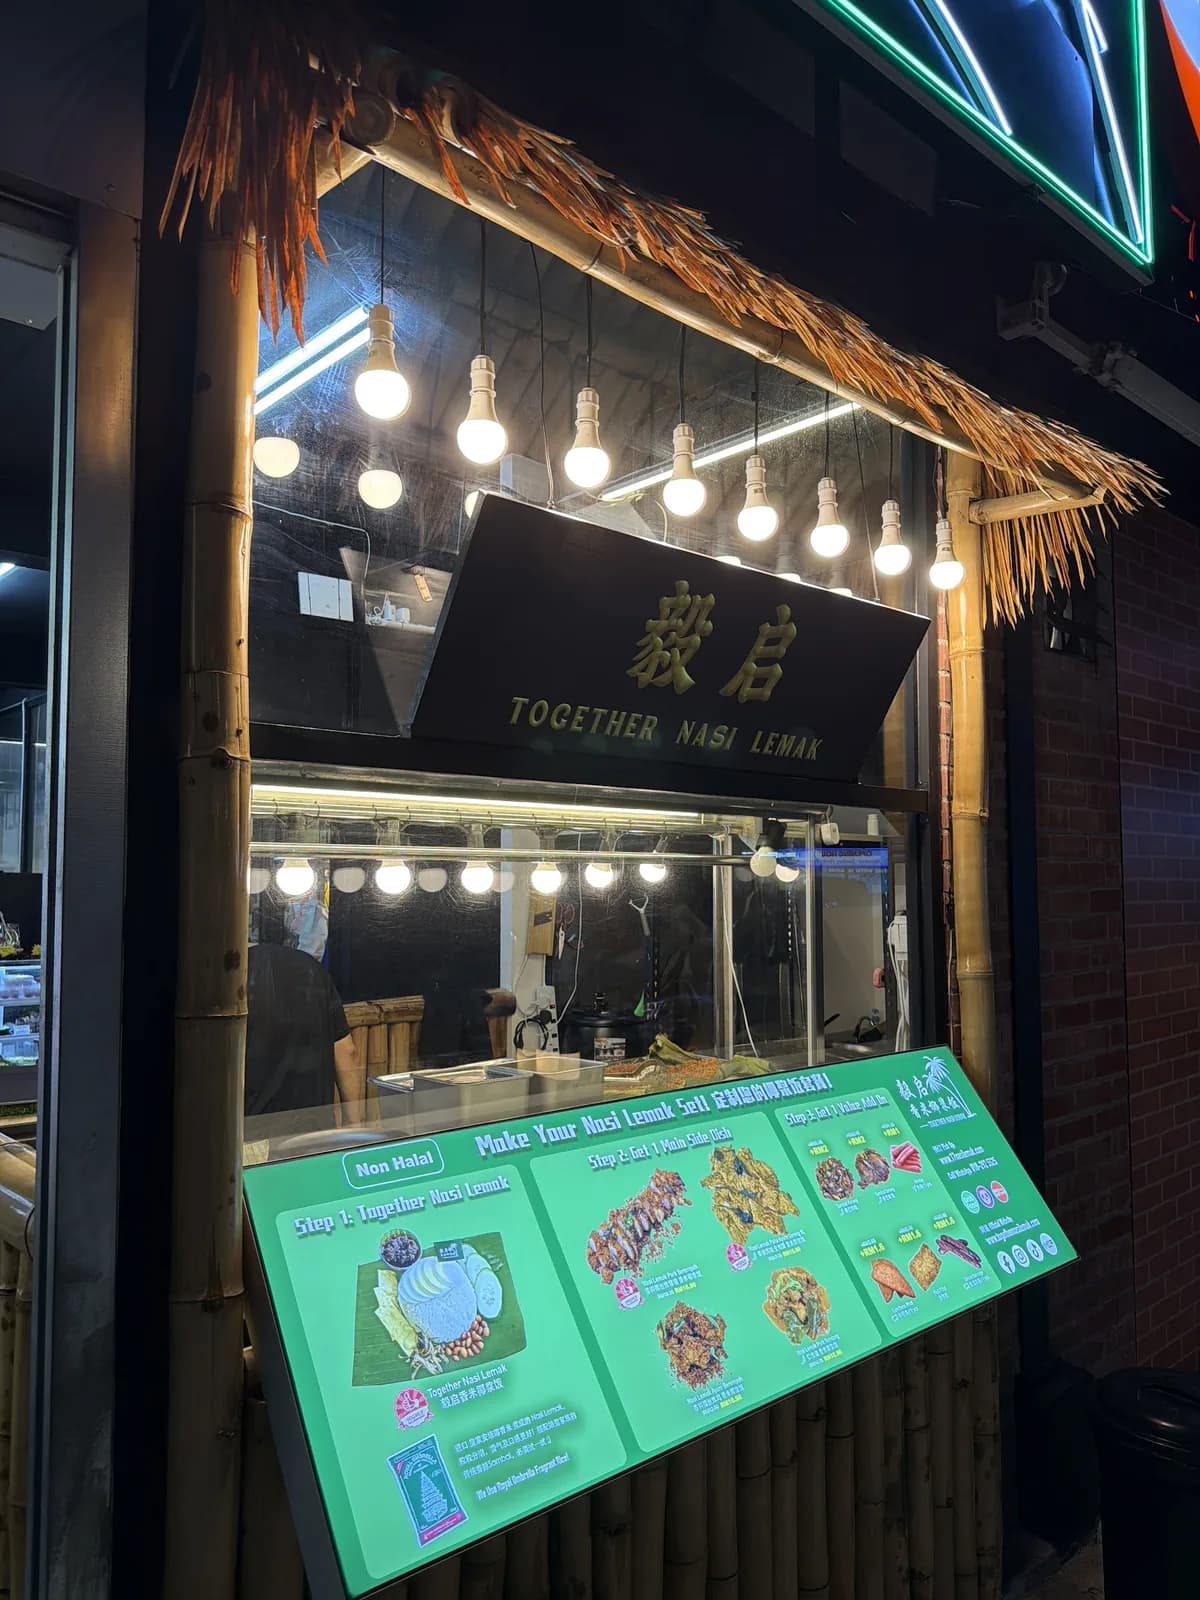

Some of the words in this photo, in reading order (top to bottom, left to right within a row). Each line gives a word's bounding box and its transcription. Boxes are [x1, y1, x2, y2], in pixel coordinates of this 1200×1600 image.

[509, 696, 659, 741] TOGETHER
[675, 719, 737, 750] NASI
[751, 730, 823, 760] LEMAK
[474, 1130, 531, 1156] Make
[533, 1124, 577, 1143] Your
[580, 1110, 622, 1134] Nasi
[622, 1101, 676, 1126] Lemak
[675, 1095, 710, 1115] Set!
[784, 1112, 807, 1126] Step
[814, 1106, 832, 1118] Get
[355, 1162, 390, 1177] Non
[392, 1151, 434, 1170] Halal
[587, 1154, 616, 1169] Step
[616, 1149, 629, 1162] 2:
[629, 1144, 651, 1159] Get
[651, 1142, 659, 1154] 1
[660, 1137, 687, 1152] Main
[686, 1131, 710, 1146] Side
[709, 1127, 732, 1141] Dish
[294, 1216, 335, 1236] Step
[338, 1209, 353, 1224] 1:
[355, 1196, 425, 1225] Together
[429, 1184, 463, 1204] Nasi
[464, 1175, 510, 1196] Lemak
[427, 1380, 461, 1398] Together
[462, 1372, 481, 1386] Nasi
[480, 1364, 508, 1380] Lemak
